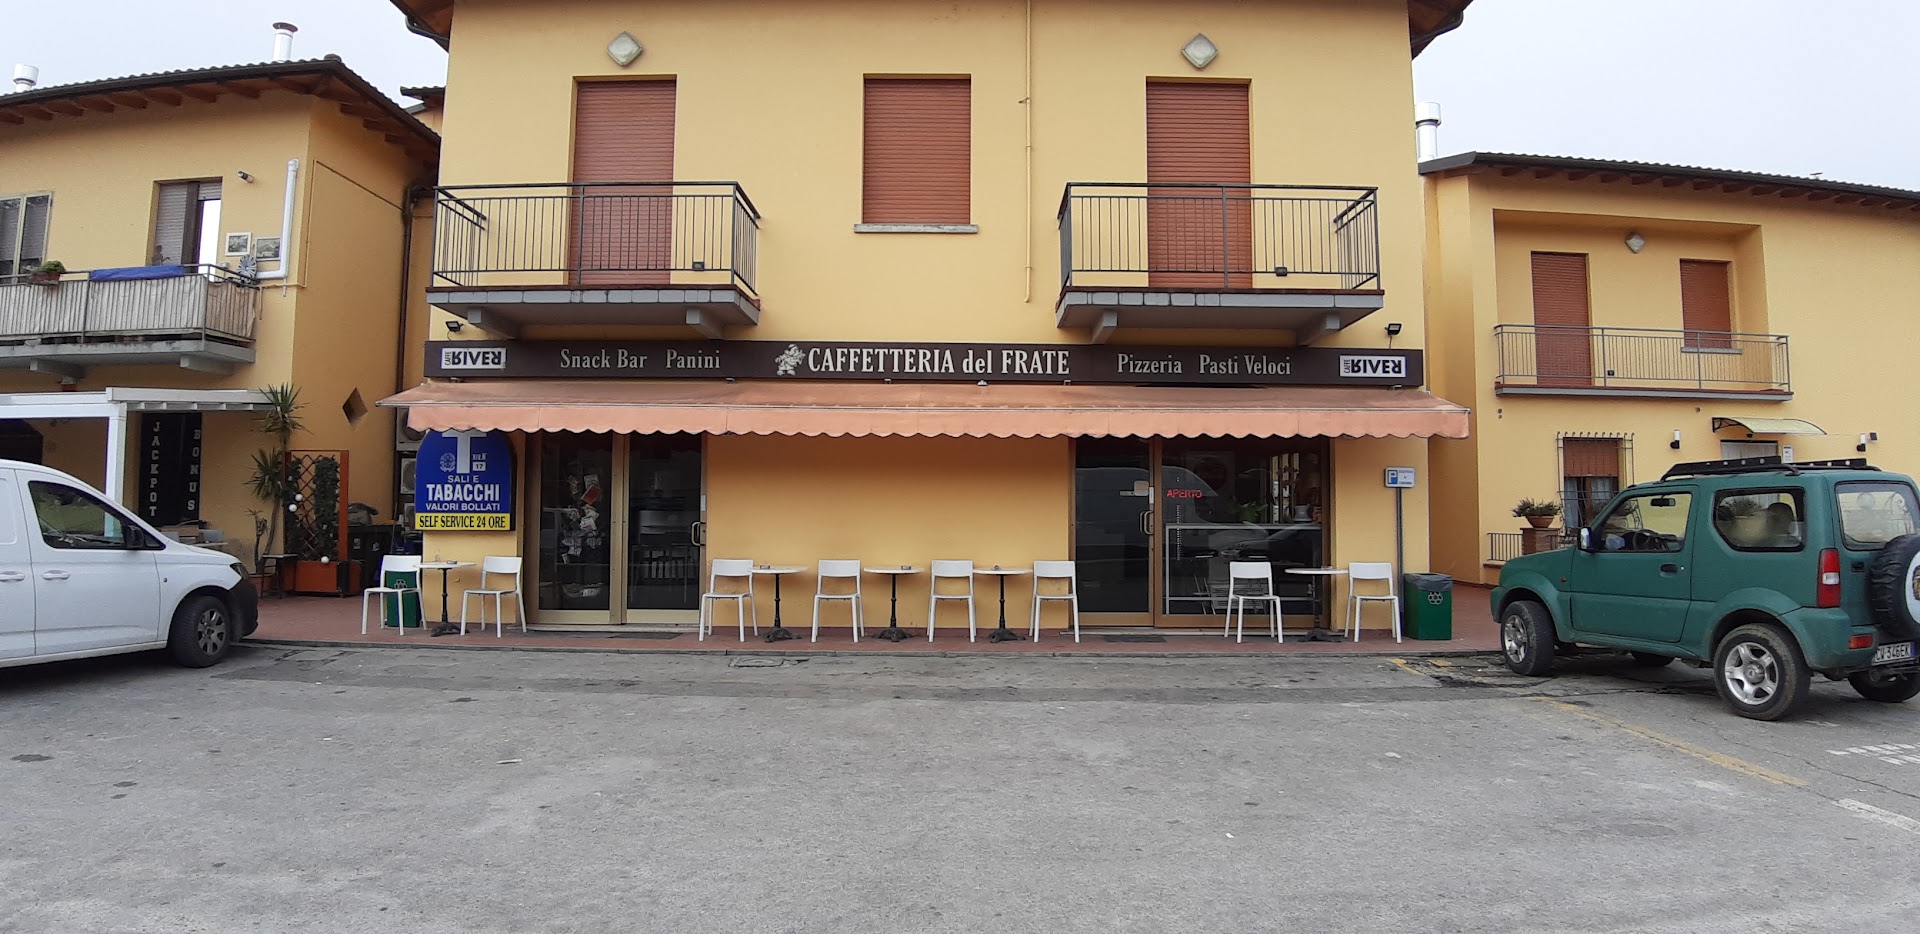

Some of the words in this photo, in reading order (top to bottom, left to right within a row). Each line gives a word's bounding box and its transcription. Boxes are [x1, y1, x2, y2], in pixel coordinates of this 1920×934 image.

[451, 350, 502, 366] RIVER
[560, 348, 611, 368] Snack
[617, 348, 648, 368] Bar
[665, 348, 721, 369] Panini
[808, 347, 955, 374] CAFFETTERIA
[962, 349, 992, 374] del
[1001, 349, 1070, 375] FRATE
[1117, 353, 1182, 374] Pizzeria
[1199, 354, 1239, 375] Pasti
[1244, 354, 1291, 375] Veloci
[1351, 359, 1402, 374] RIVER
[149, 421, 161, 517] JACKPOT
[187, 429, 202, 511] BONUS
[1388, 470, 1397, 484] P
[447, 475, 470, 483] SALI
[473, 475, 480, 483] E
[426, 483, 500, 502] TABACCHI
[1166, 488, 1203, 499] APERTO
[425, 502, 459, 511] VALORI
[461, 502, 501, 511] BOLLATI
[419, 515, 439, 528] SELF
[440, 515, 475, 528] SERVICE
[476, 515, 487, 528] 24
[488, 515, 506, 529] ORE
